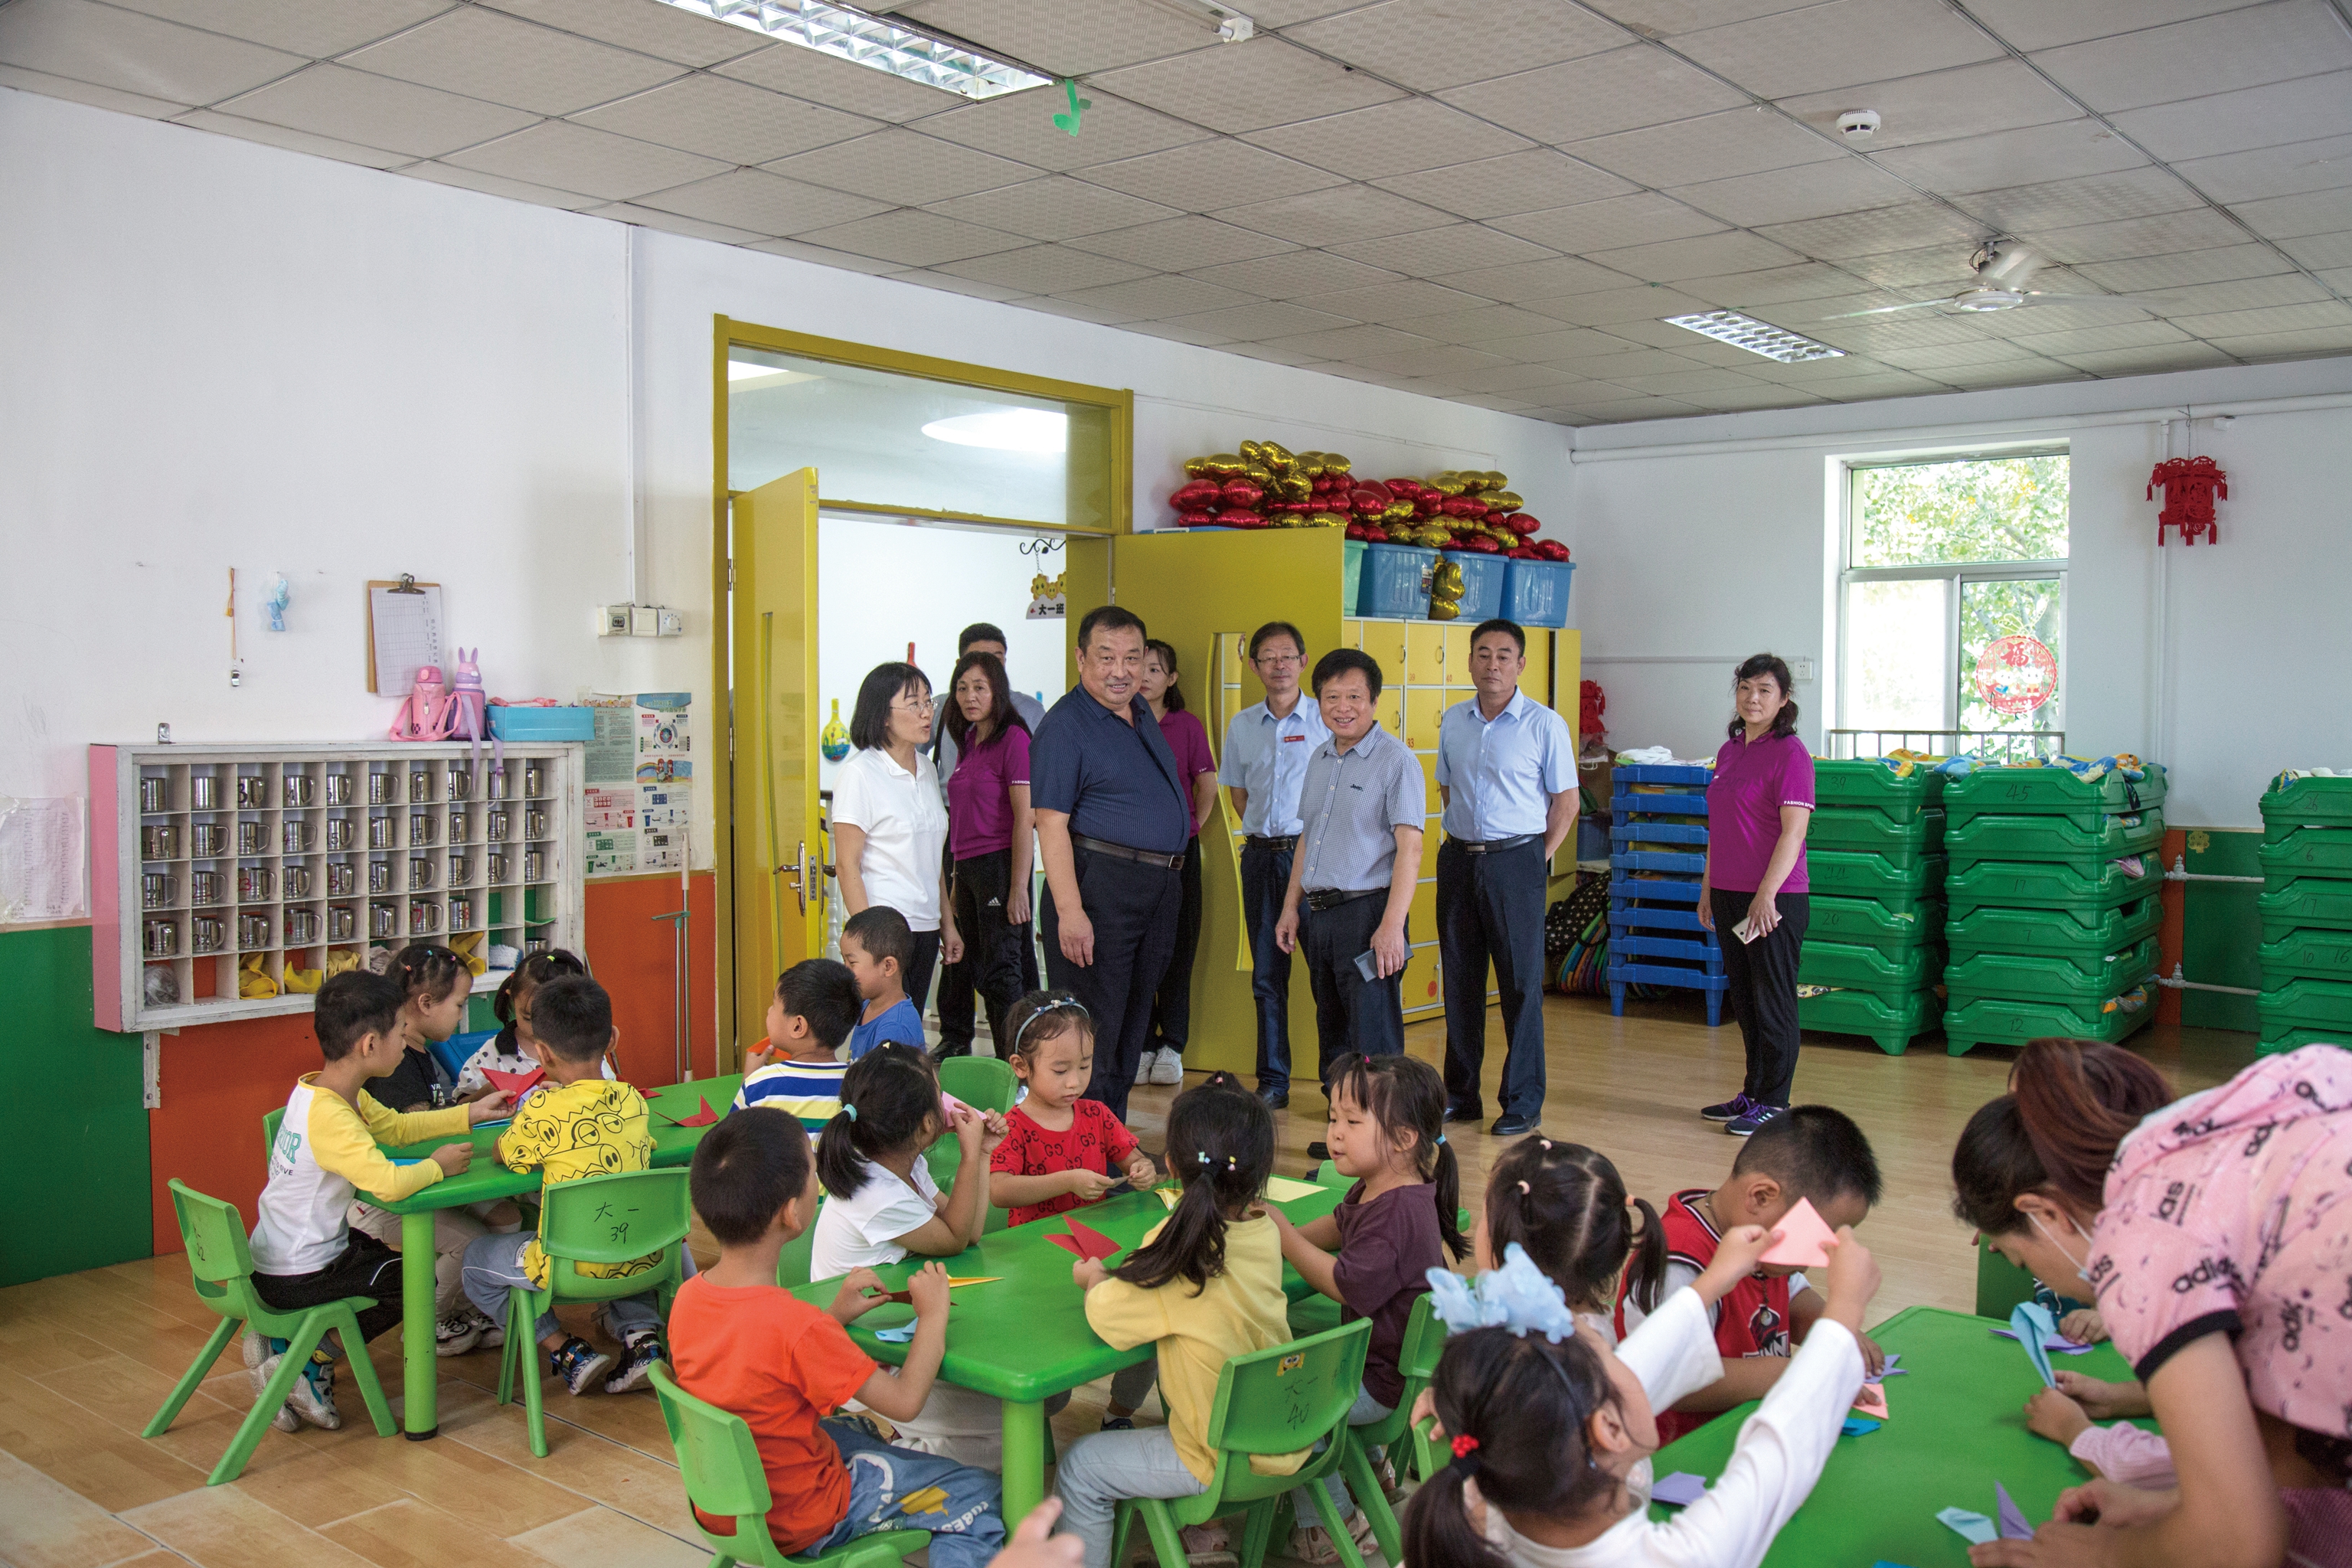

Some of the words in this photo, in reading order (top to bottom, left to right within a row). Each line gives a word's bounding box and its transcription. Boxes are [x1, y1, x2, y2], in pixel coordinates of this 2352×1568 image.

[1038, 603, 1064, 616] 大一班
[2000, 642, 2029, 668] 福
[1446, 674, 1452, 682] 40
[1407, 738, 1414, 748] 33
[2005, 784, 2034, 802] 45
[2304, 793, 2319, 812] 26
[2306, 847, 2314, 862] 6
[2014, 878, 2027, 893] 17
[2301, 897, 2318, 916] 17
[1822, 912, 1840, 926] 20
[2023, 929, 2033, 942] 7
[2302, 949, 2315, 965] 10
[2334, 949, 2350, 964] 16
[2009, 1018, 2024, 1034] 12
[610, 1222, 629, 1244] 39
[1287, 1403, 1309, 1431] 40
